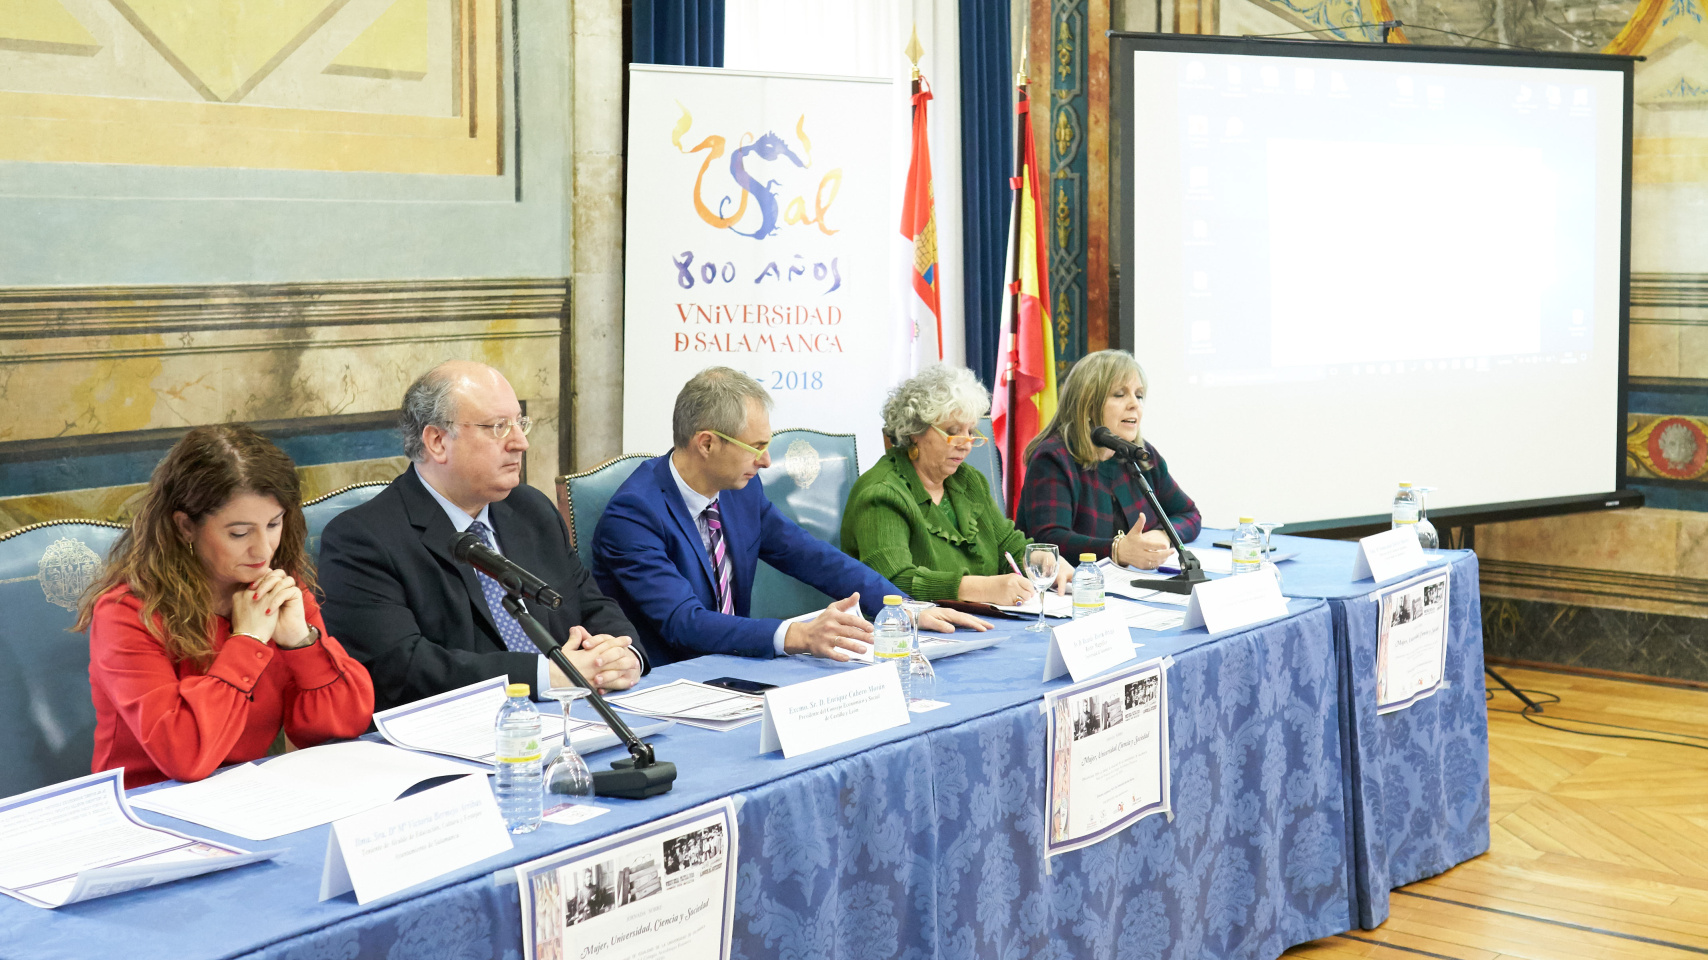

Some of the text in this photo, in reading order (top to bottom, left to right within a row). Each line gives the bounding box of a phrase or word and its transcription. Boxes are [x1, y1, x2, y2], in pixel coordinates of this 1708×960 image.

[672, 251, 736, 289] 800
[694, 332, 843, 353] SALAMANCA
[771, 370, 823, 390] 2018
[580, 941, 609, 960] Mujer,
[611, 922, 653, 946] Universidad,
[654, 914, 679, 932] Ciencia
[685, 898, 710, 921] Sociedad
